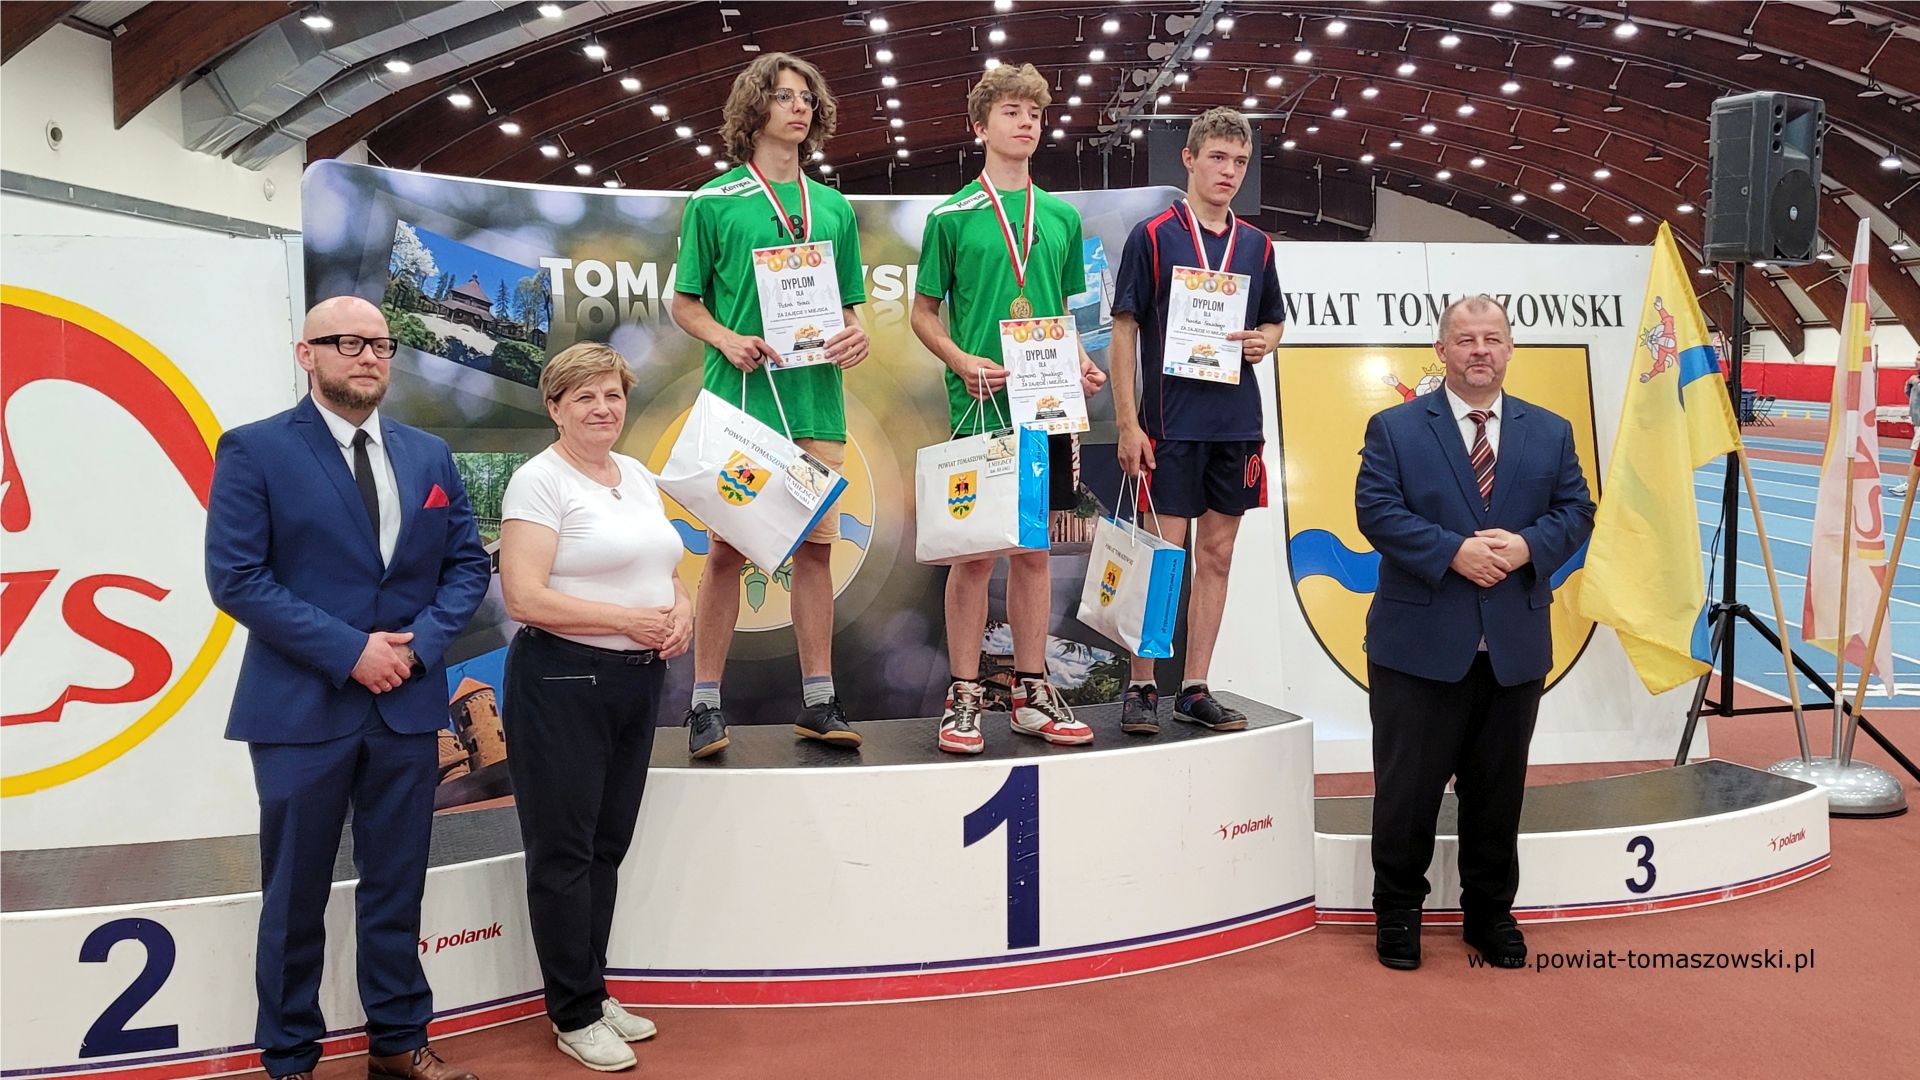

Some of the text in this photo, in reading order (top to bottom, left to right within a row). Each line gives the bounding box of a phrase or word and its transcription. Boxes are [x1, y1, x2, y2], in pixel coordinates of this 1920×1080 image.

[771, 215, 804, 239] 18
[781, 275, 815, 291] DYPLOM
[1192, 297, 1225, 313] DYPLOM
[1025, 348, 1058, 361] DYPLOM
[724, 427, 750, 446] POWIAT
[937, 460, 956, 470] POWIAT
[1231, 814, 1273, 840] polanik
[1779, 827, 1806, 851] polanik
[963, 764, 1040, 950] 1
[1625, 835, 1656, 894] 3
[436, 922, 503, 954] polanik
[78, 917, 179, 1059] 2
